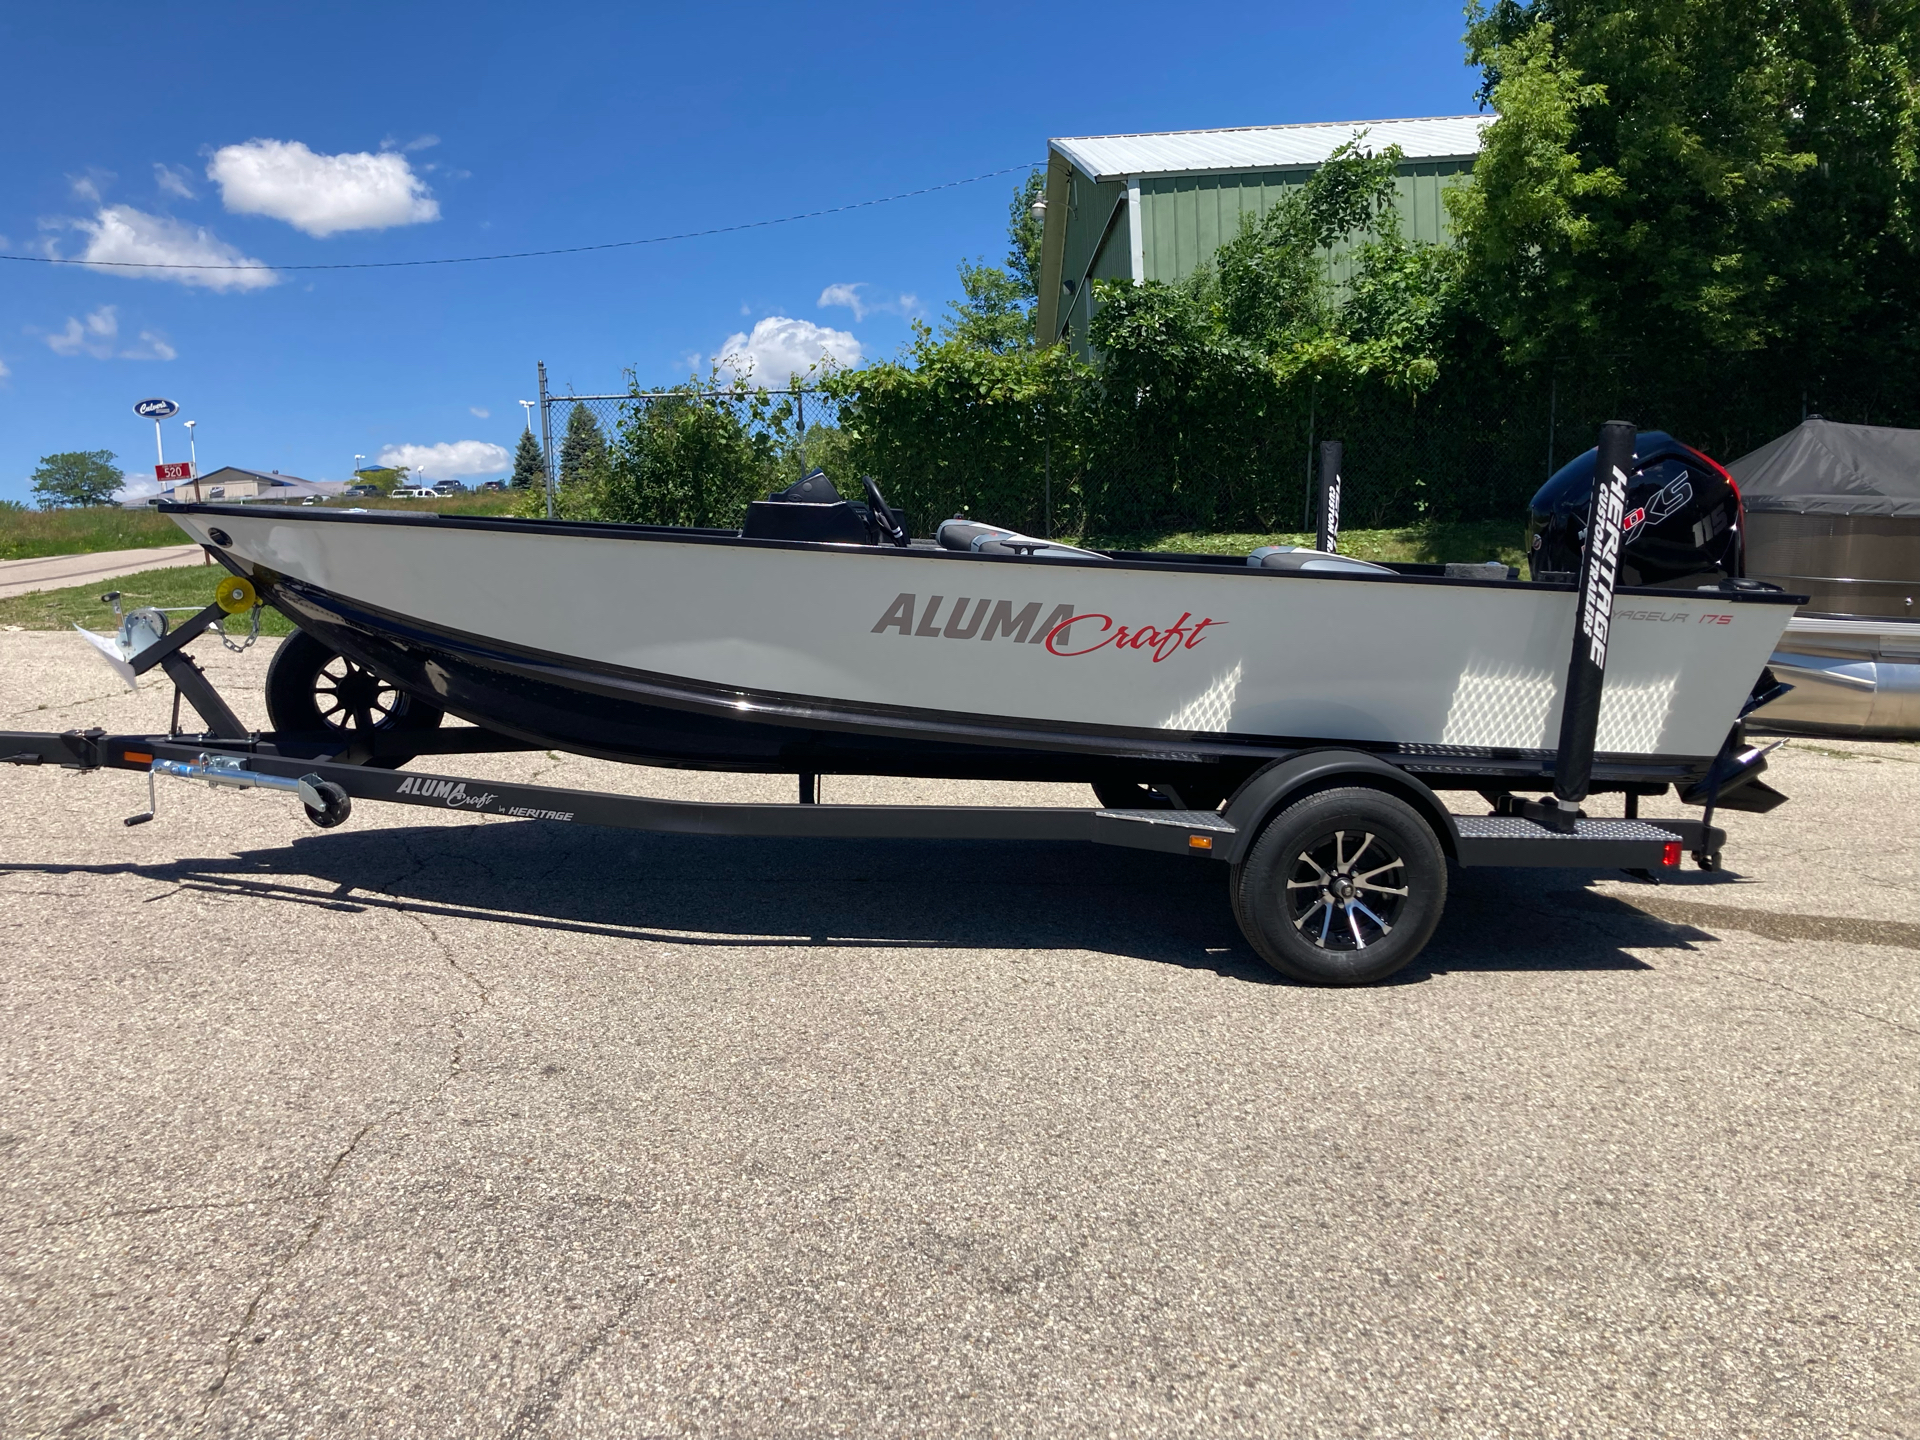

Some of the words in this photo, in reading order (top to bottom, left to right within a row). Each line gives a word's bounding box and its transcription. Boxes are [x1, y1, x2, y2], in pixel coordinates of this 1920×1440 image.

[164, 467, 182, 478] 520
[1327, 485, 1336, 534] CUSTOM
[1591, 482, 1609, 557] CUSTOM
[1692, 502, 1728, 549] 115
[1590, 465, 1628, 670] HERITAGE
[1583, 556, 1601, 638] TRAILERS
[1611, 610, 1690, 623] YAGEUR
[1699, 614, 1734, 625] 175
[508, 806, 574, 822] HERITAGE
